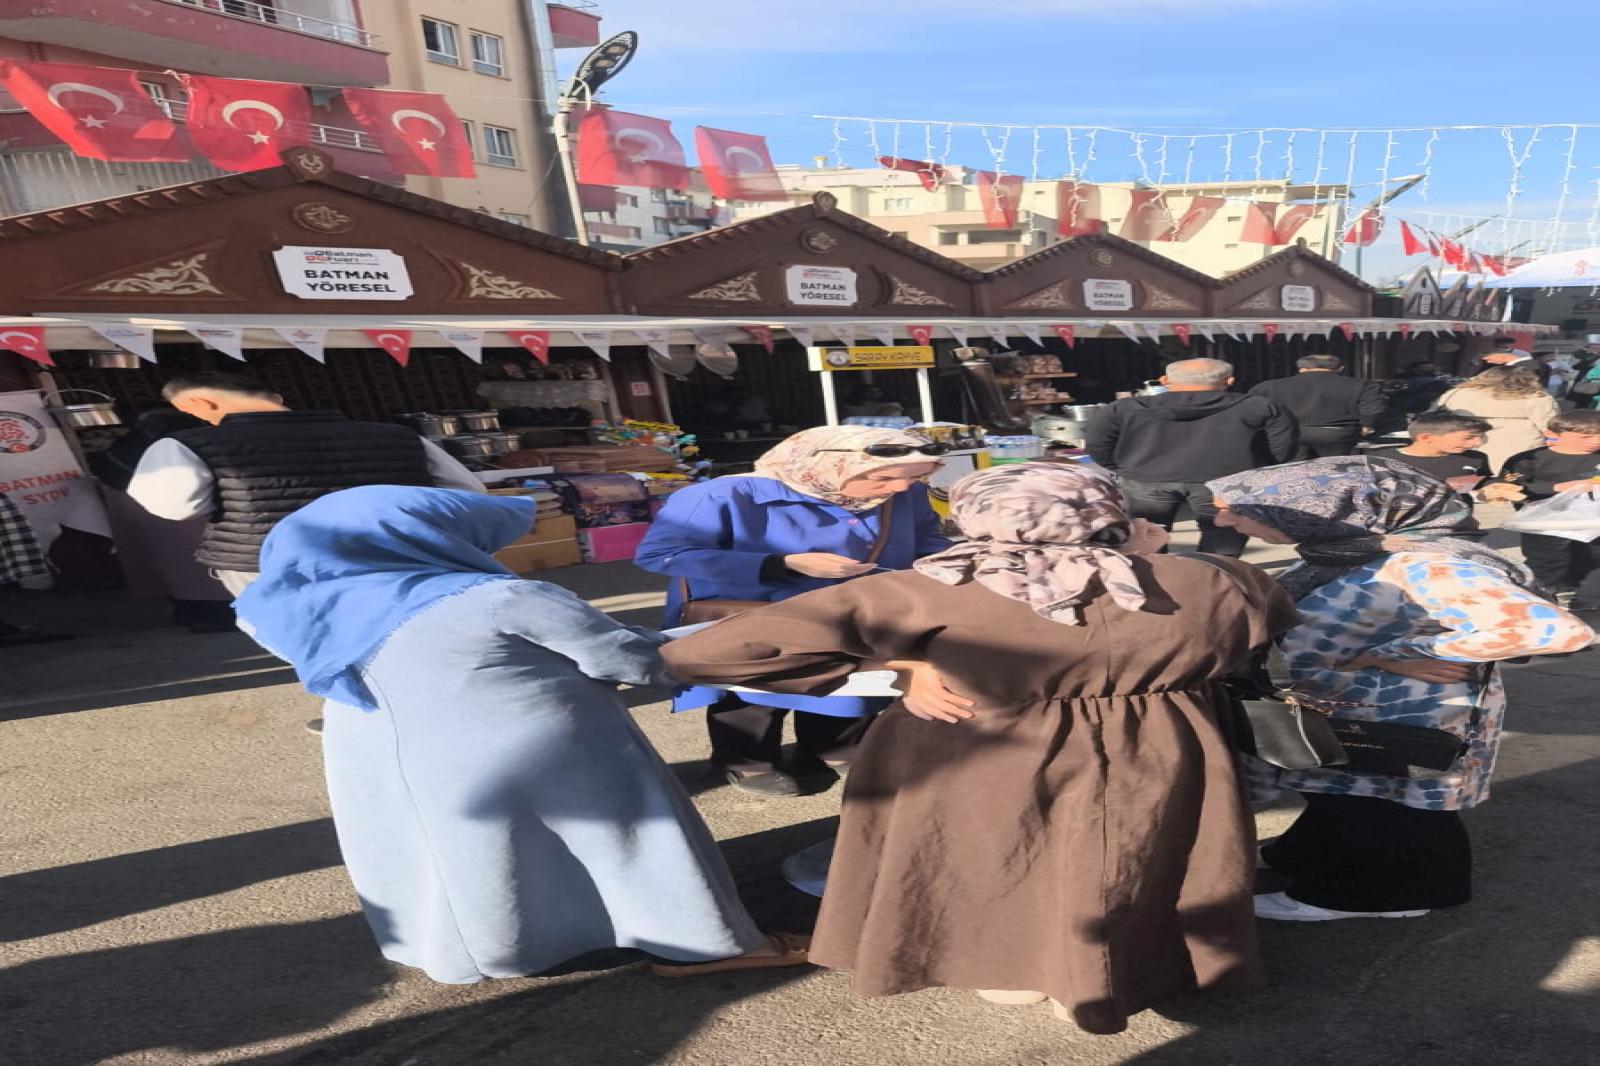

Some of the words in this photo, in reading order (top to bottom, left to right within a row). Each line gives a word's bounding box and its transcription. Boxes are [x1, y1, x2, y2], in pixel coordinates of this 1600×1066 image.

[304, 269, 390, 280] BATMAN
[305, 281, 397, 292] YÖRESEL
[801, 282, 847, 291] BATMAN
[800, 291, 848, 301] YÖRESEL
[0, 470, 81, 492] BATMAN
